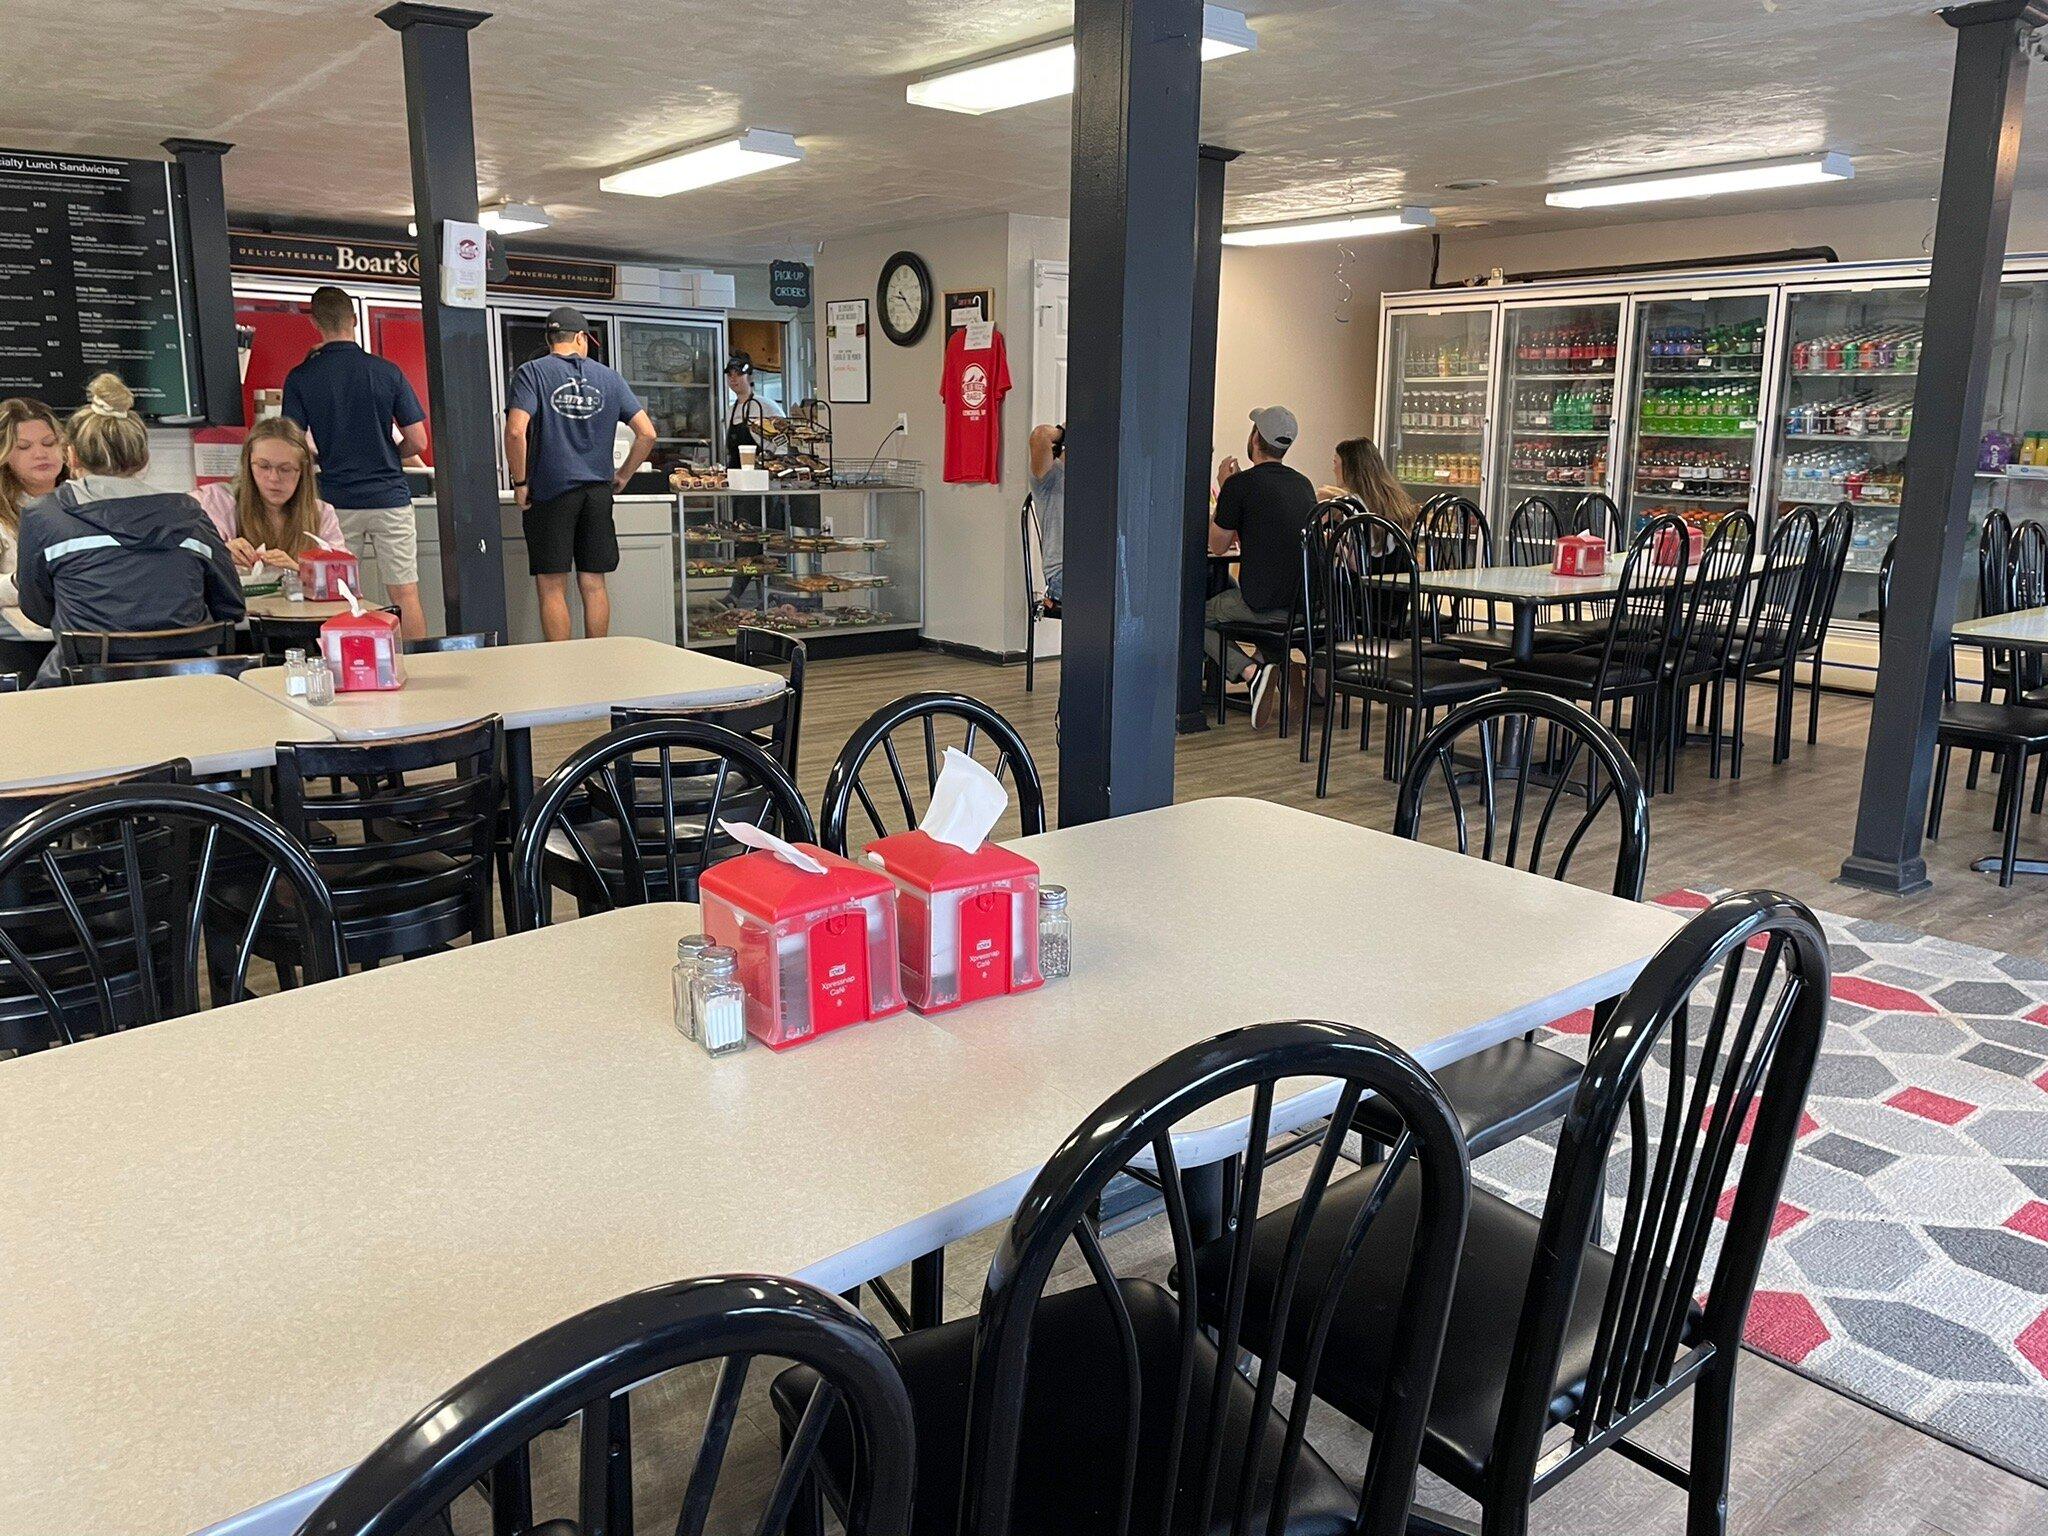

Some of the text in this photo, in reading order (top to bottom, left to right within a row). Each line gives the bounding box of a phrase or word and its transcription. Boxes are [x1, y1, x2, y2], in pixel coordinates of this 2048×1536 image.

[0, 157, 120, 175] cialty Lunch Sandwiches
[239, 246, 408, 275] DELICATESSEN Boar's
[509, 270, 610, 284] NWAVERING STANDARDS
[775, 286, 806, 297] ORDERS
[969, 950, 1000, 962] Xpressnap
[821, 975, 855, 990] Xpressnap
